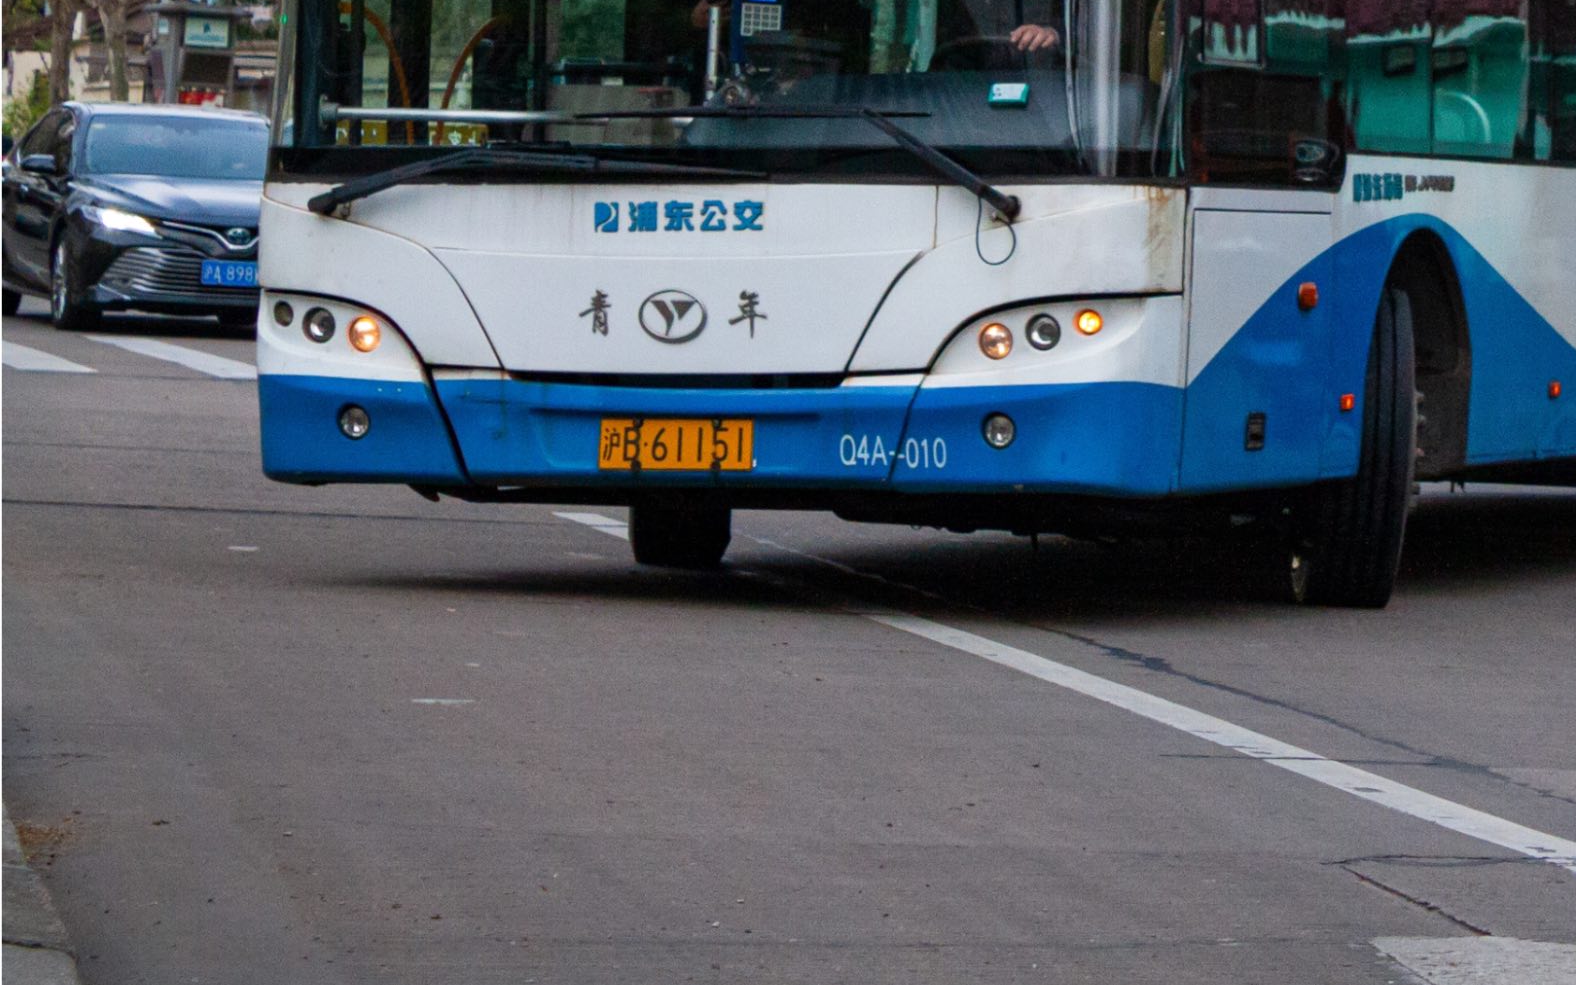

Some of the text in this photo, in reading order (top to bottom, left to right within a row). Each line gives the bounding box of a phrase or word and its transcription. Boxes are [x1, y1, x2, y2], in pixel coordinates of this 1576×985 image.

[628, 199, 765, 233] 浦东公交
[839, 434, 947, 469] Q4A-010
